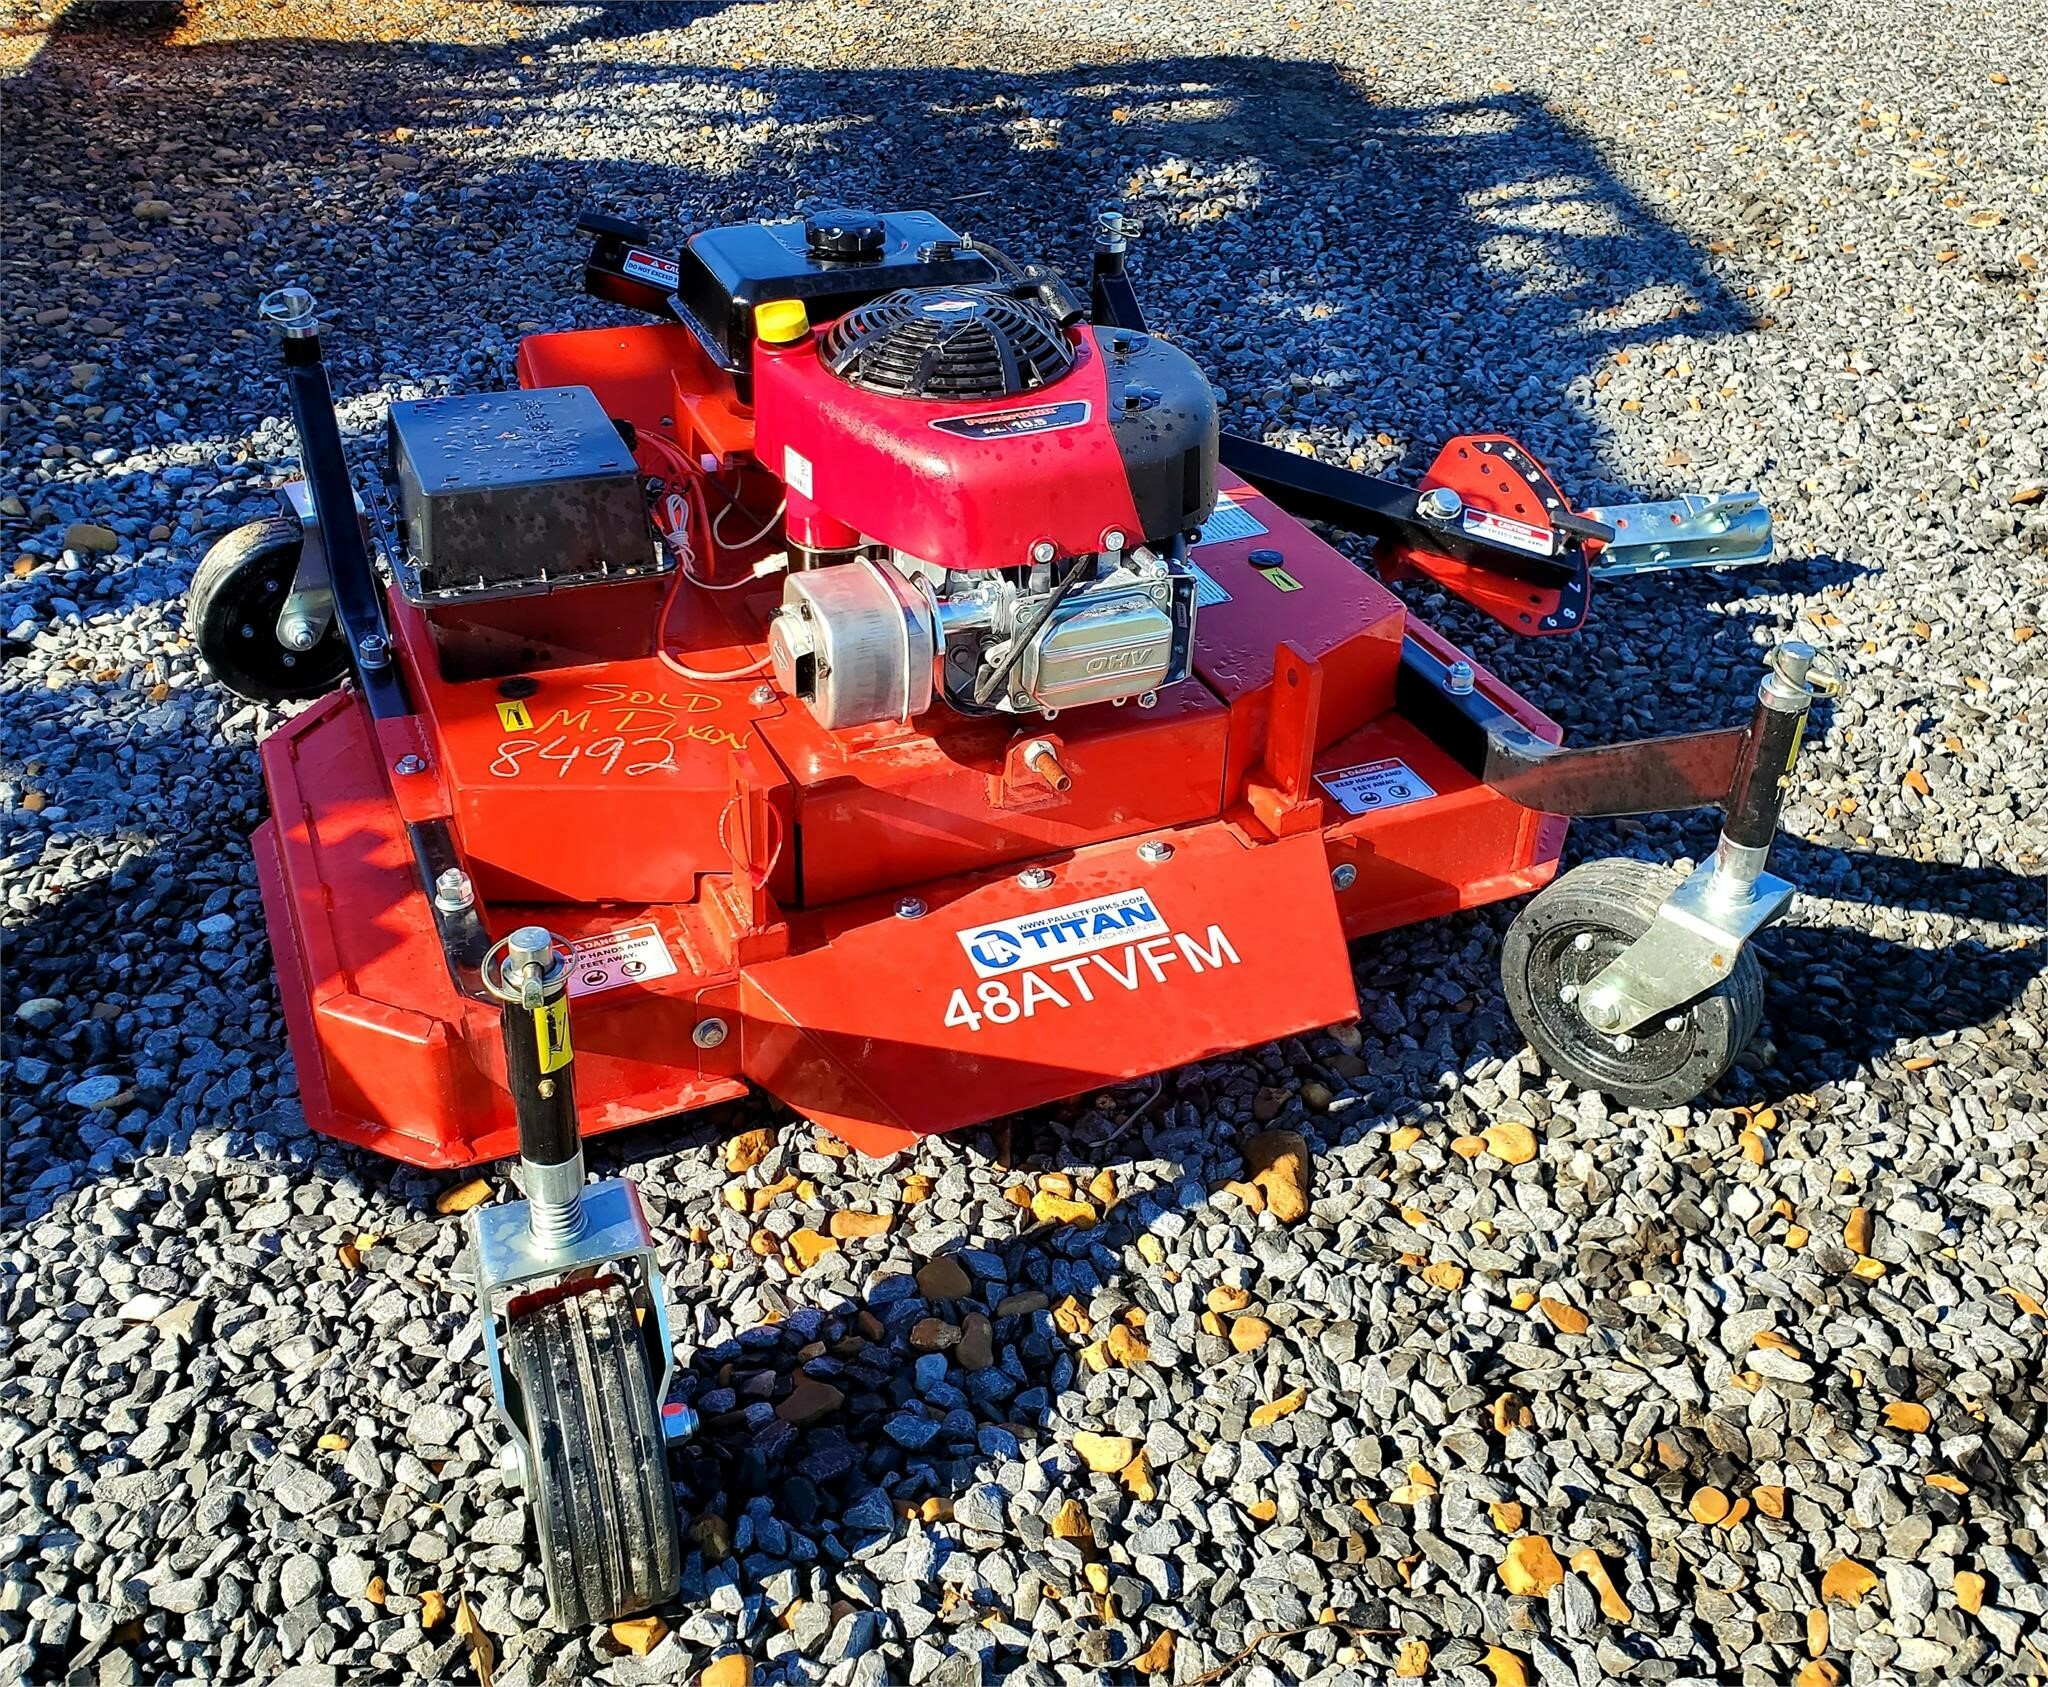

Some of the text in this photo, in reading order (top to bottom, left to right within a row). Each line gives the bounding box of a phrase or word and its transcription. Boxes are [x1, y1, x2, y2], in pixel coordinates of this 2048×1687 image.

[1010, 418, 1048, 430] 10.5
[1526, 470, 1540, 483] 3
[1563, 607, 1576, 619] 8
[1087, 648, 1153, 674] OHV
[583, 683, 722, 713] SOLD
[489, 735, 680, 778] 8492
[1334, 769, 1402, 788] KEEP HANDS AND
[1347, 764, 1384, 777] DANGER
[1016, 895, 1146, 931] WWW.PALLETFORKS.COM
[1021, 902, 1157, 949] TITAN
[1078, 922, 1161, 946] ATTACHMENTS
[584, 933, 631, 949] DANGER
[588, 946, 624, 959] HANDS
[627, 940, 649, 950] AND
[580, 960, 604, 970] FEET
[943, 923, 1242, 1032] 48ATVFM
